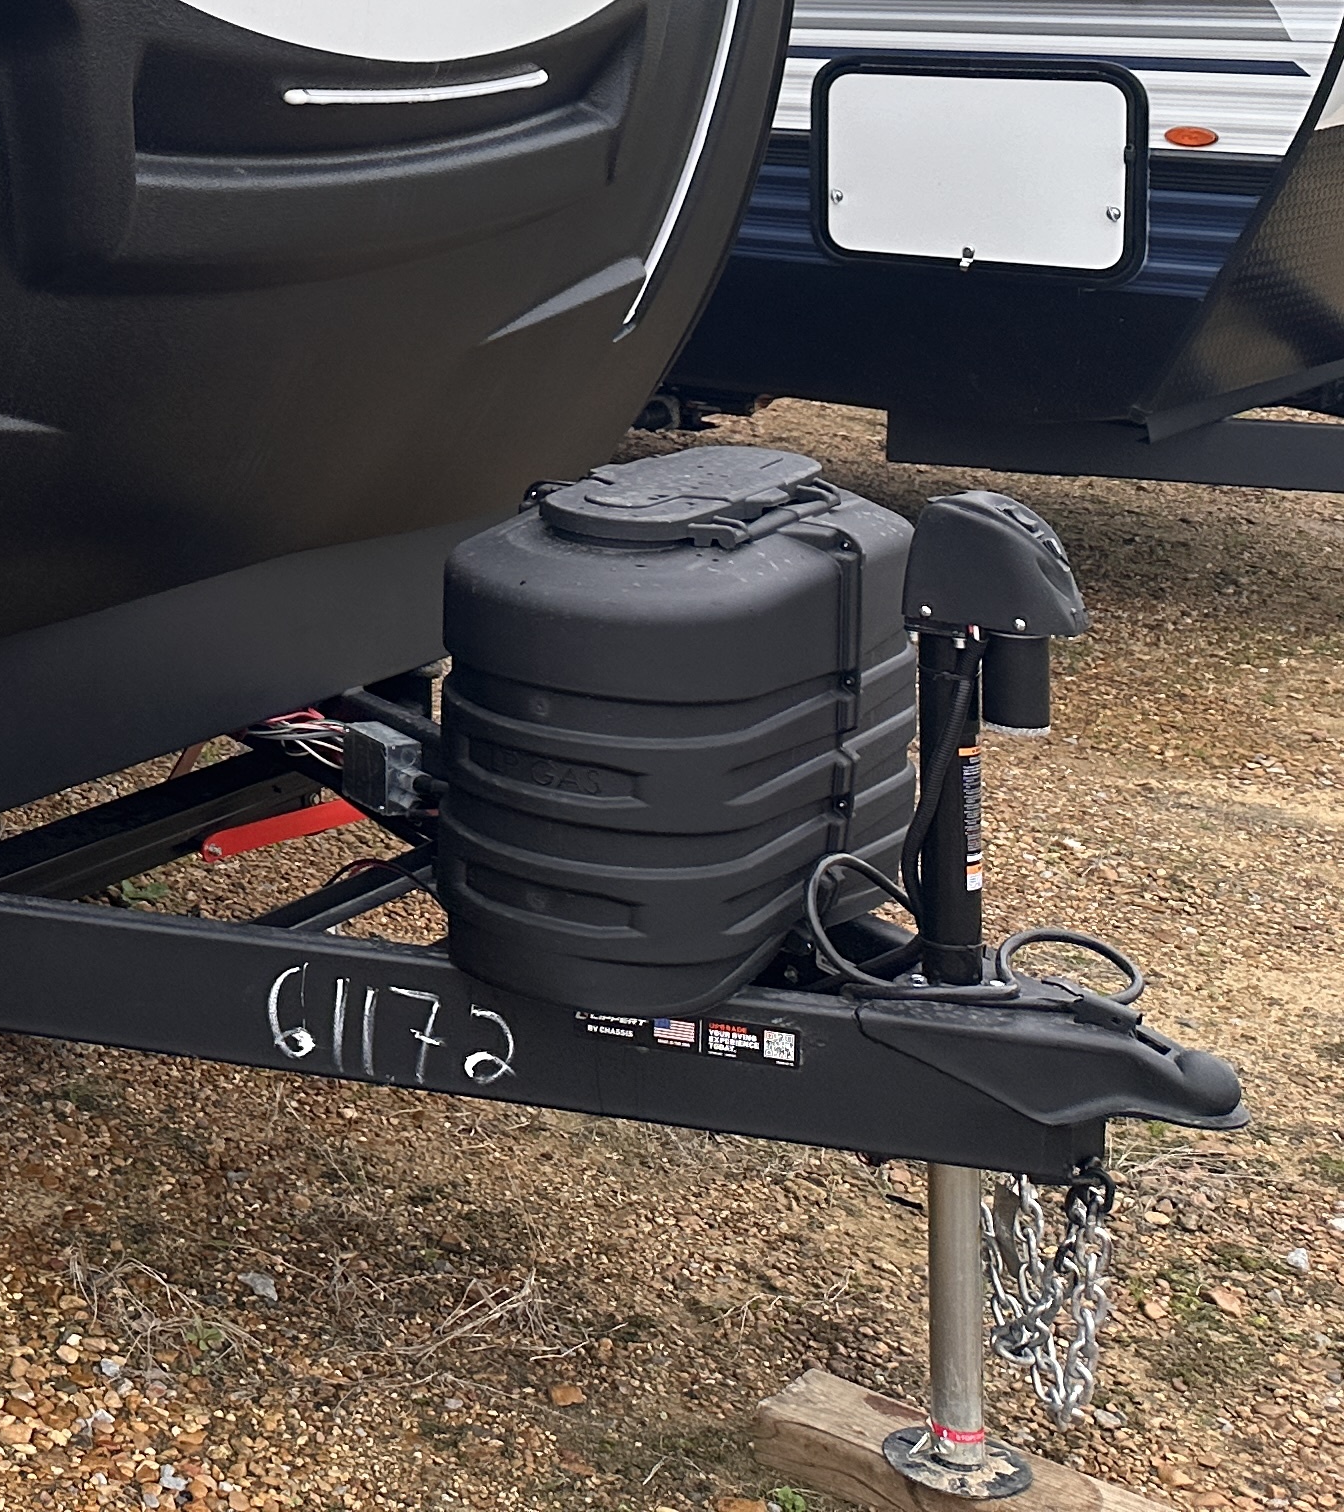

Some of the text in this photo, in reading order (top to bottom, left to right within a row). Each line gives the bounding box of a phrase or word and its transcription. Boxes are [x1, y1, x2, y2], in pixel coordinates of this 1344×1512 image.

[530, 758, 601, 796] GAS
[267, 961, 517, 1085] 61172
[708, 1035, 760, 1050] EXPERIENCE
